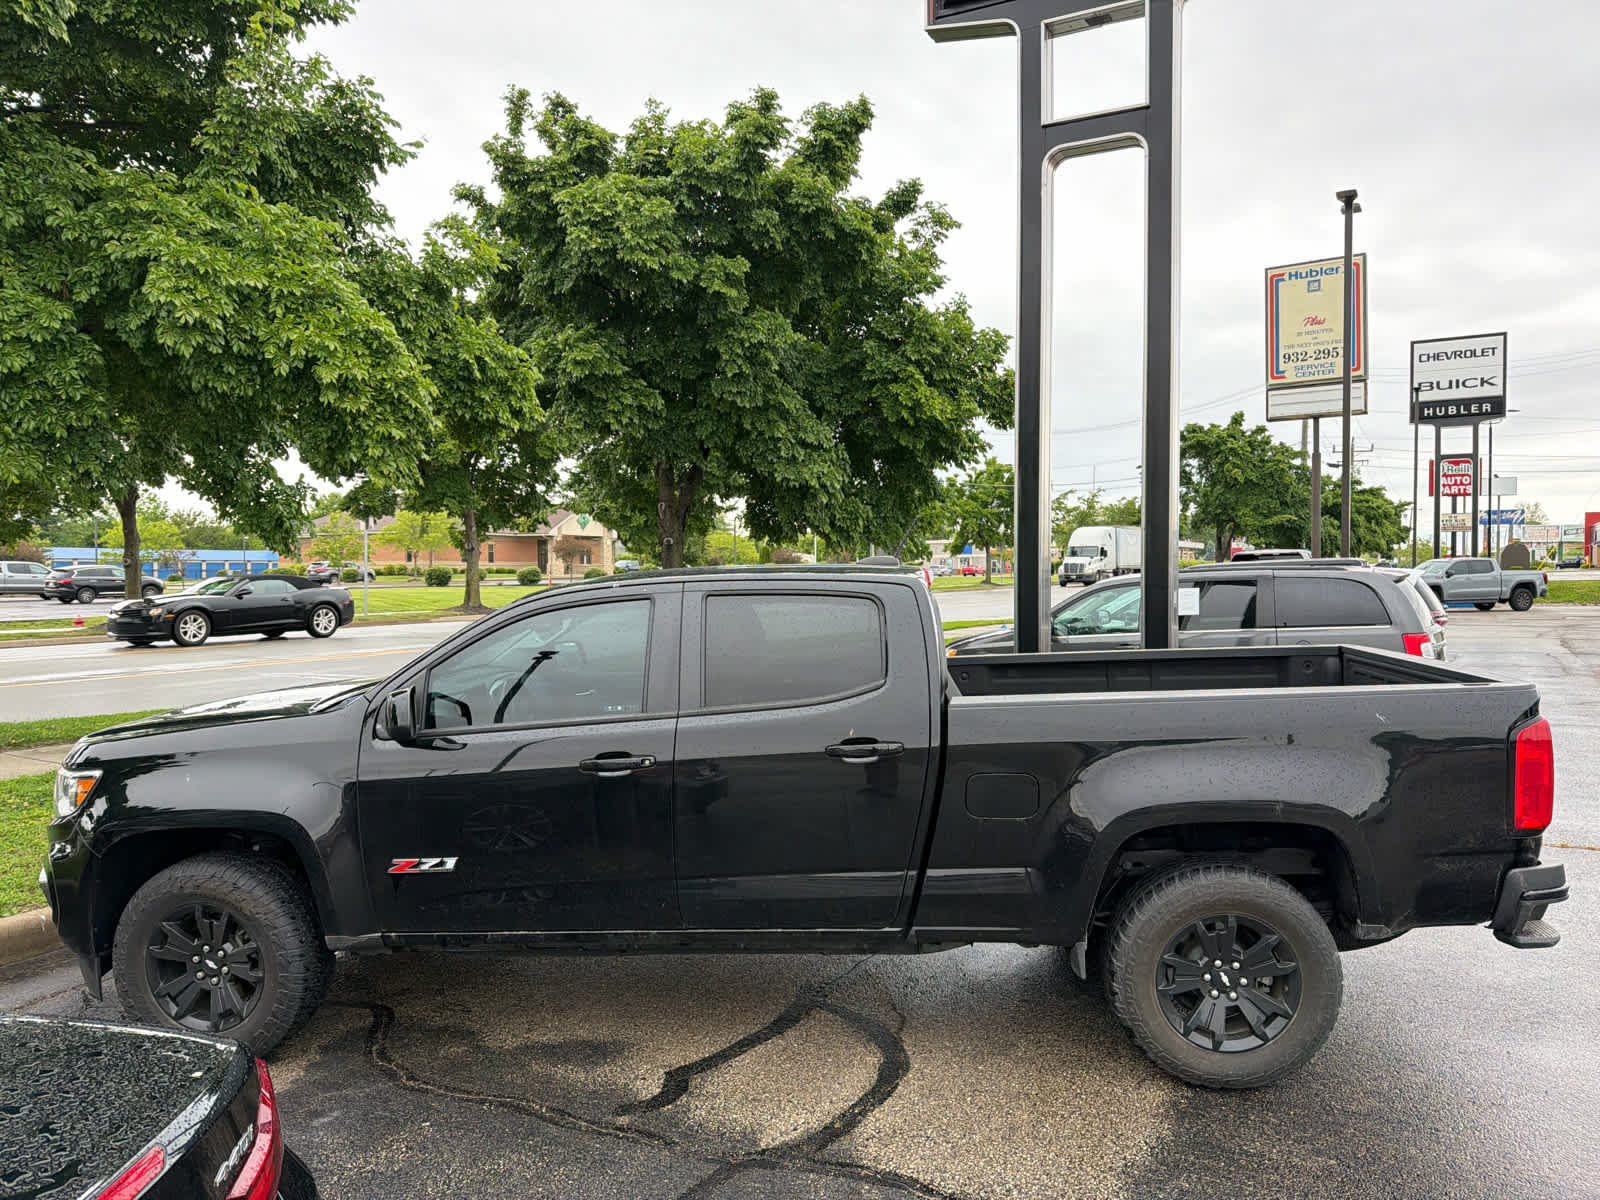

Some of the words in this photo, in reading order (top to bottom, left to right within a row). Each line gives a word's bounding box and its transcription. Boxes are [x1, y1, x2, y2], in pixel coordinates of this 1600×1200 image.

[1288, 266, 1341, 281] Hubler
[1303, 315, 1327, 327] Plus
[1282, 346, 1344, 364] 932-295
[1418, 347, 1498, 363] CHEVROLET
[1294, 361, 1336, 371] SERVICE
[1295, 368, 1335, 378] CENTER
[1417, 376, 1498, 392] BUICK
[1424, 403, 1492, 416] HUBLER
[1441, 485, 1473, 494] ARTS
[387, 857, 459, 873] Z71
